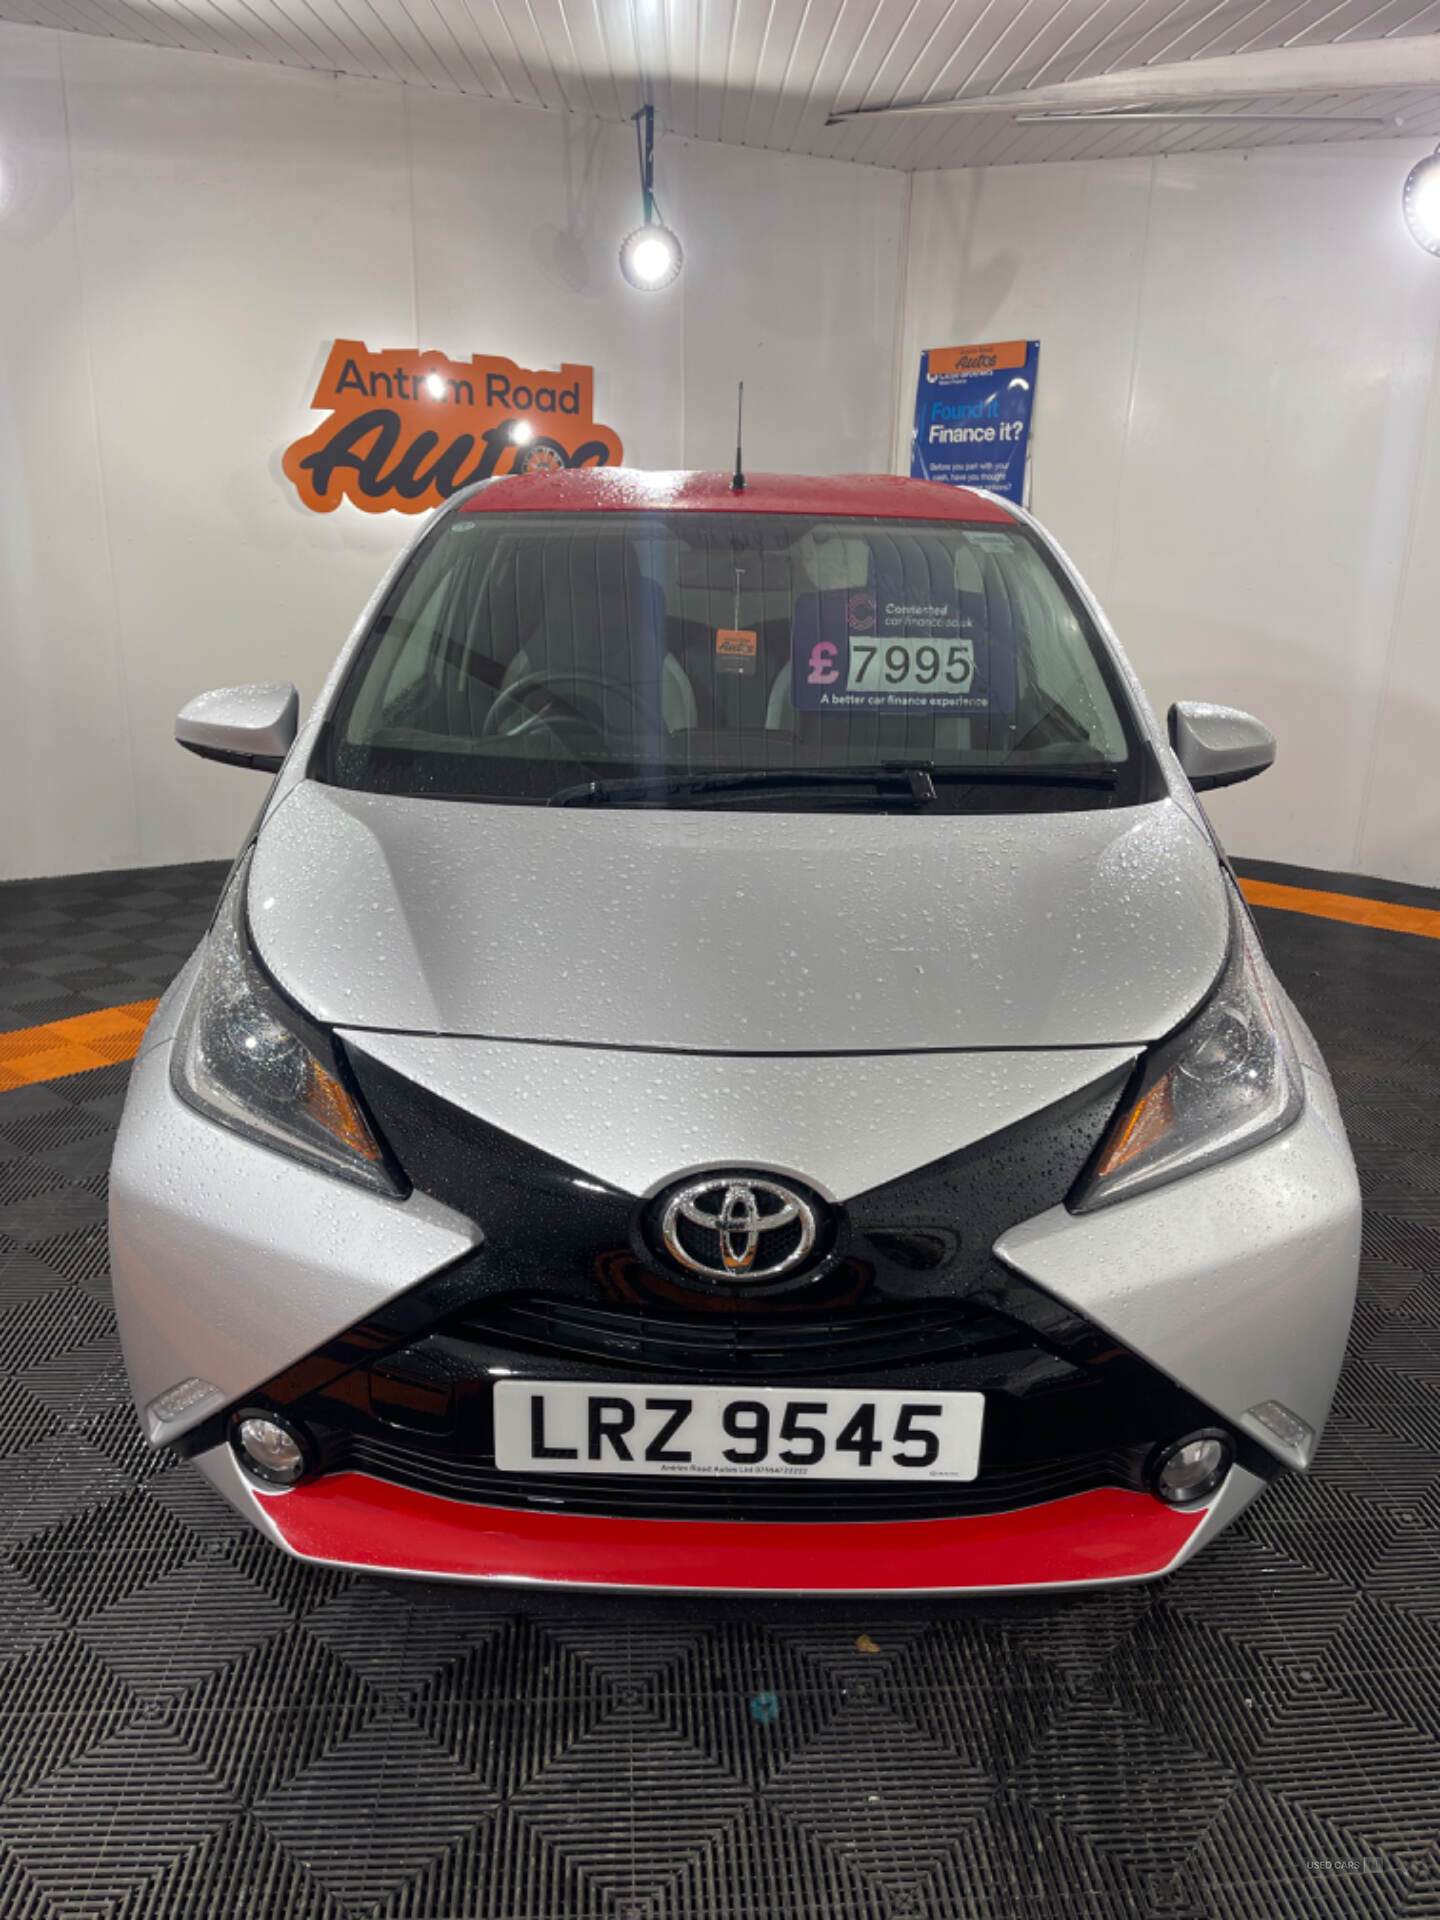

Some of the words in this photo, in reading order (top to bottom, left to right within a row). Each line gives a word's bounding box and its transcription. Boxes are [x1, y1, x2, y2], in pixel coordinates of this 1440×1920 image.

[486, 373, 580, 415] Road
[931, 401, 984, 421] Found
[929, 424, 996, 443] Finance
[1000, 421, 1023, 440] it?
[885, 603, 947, 616] Connected
[852, 645, 971, 684] 7995
[820, 693, 829, 704] A
[832, 693, 864, 705] better
[868, 696, 884, 705] car
[887, 694, 926, 706] finance
[929, 695, 988, 708] experience
[530, 1395, 693, 1462] LRZ
[722, 1400, 943, 1468] 9545
